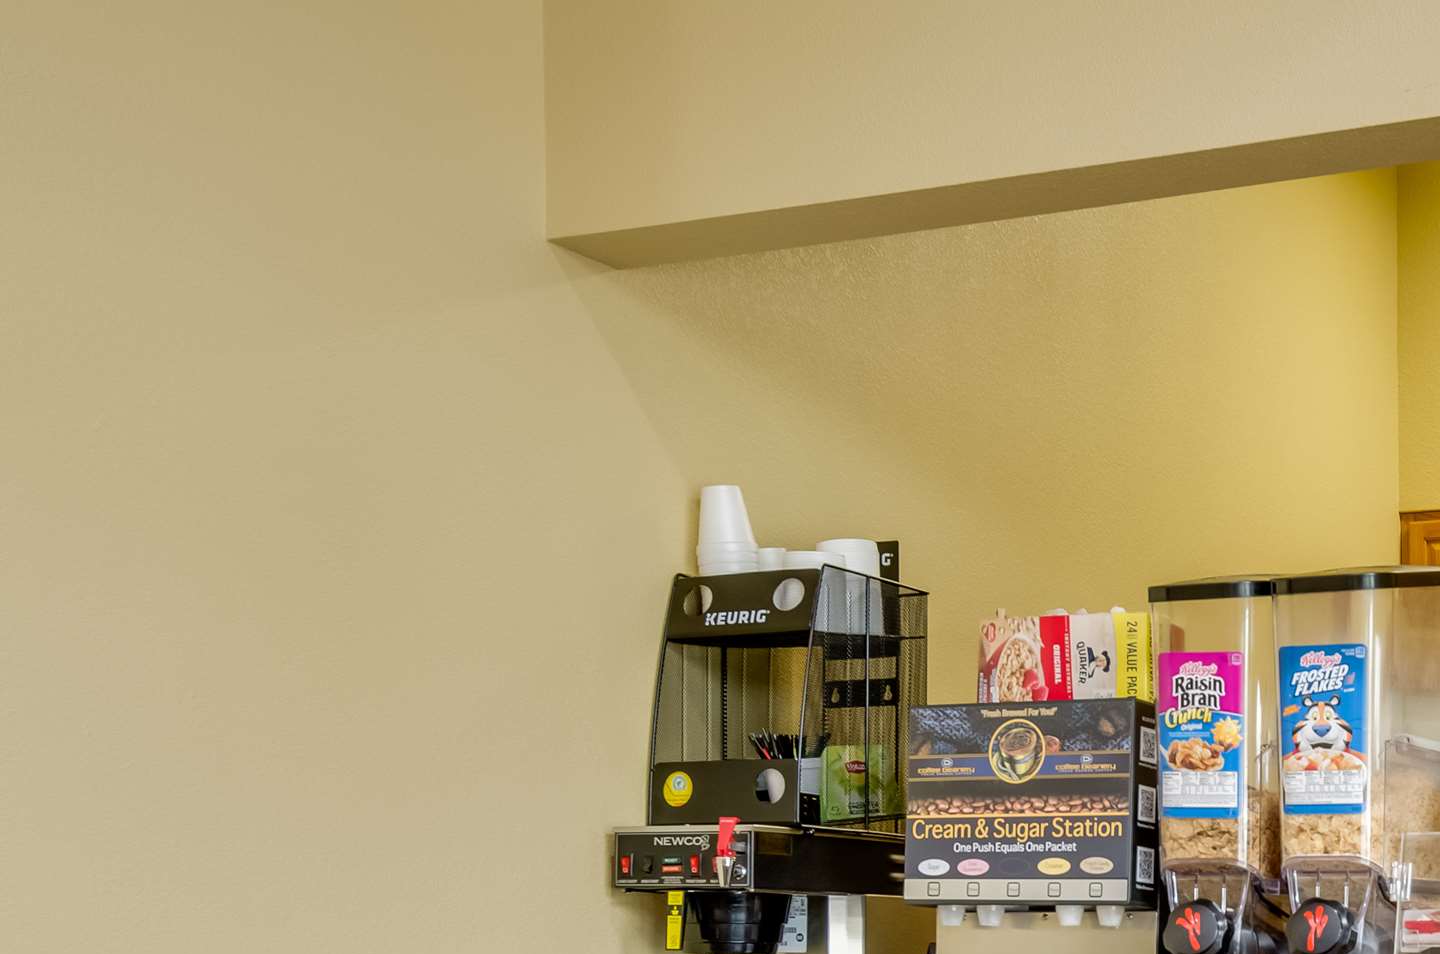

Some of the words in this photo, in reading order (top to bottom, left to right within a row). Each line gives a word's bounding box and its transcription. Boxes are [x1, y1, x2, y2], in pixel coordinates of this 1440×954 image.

[705, 609, 768, 626] KEURIG
[1126, 620, 1138, 633] 24
[1076, 641, 1087, 685] QUAKER
[1125, 641, 1138, 673] VALUE
[1174, 676, 1224, 694] Raisin
[1291, 664, 1350, 686] FROSTED
[1126, 676, 1138, 699] PAC
[1294, 677, 1344, 697] FLAKES
[1180, 693, 1219, 709] Bran
[1164, 707, 1213, 729] Crunch
[912, 818, 971, 840] Cream
[975, 818, 989, 839] &
[993, 817, 1049, 843] Sugar
[1052, 816, 1123, 838] Station
[653, 836, 702, 846] NEWCO
[953, 842, 971, 853] One
[972, 842, 994, 853] Push
[995, 841, 1025, 854] Equals
[1026, 841, 1044, 852] One
[1045, 841, 1077, 852] Packet
